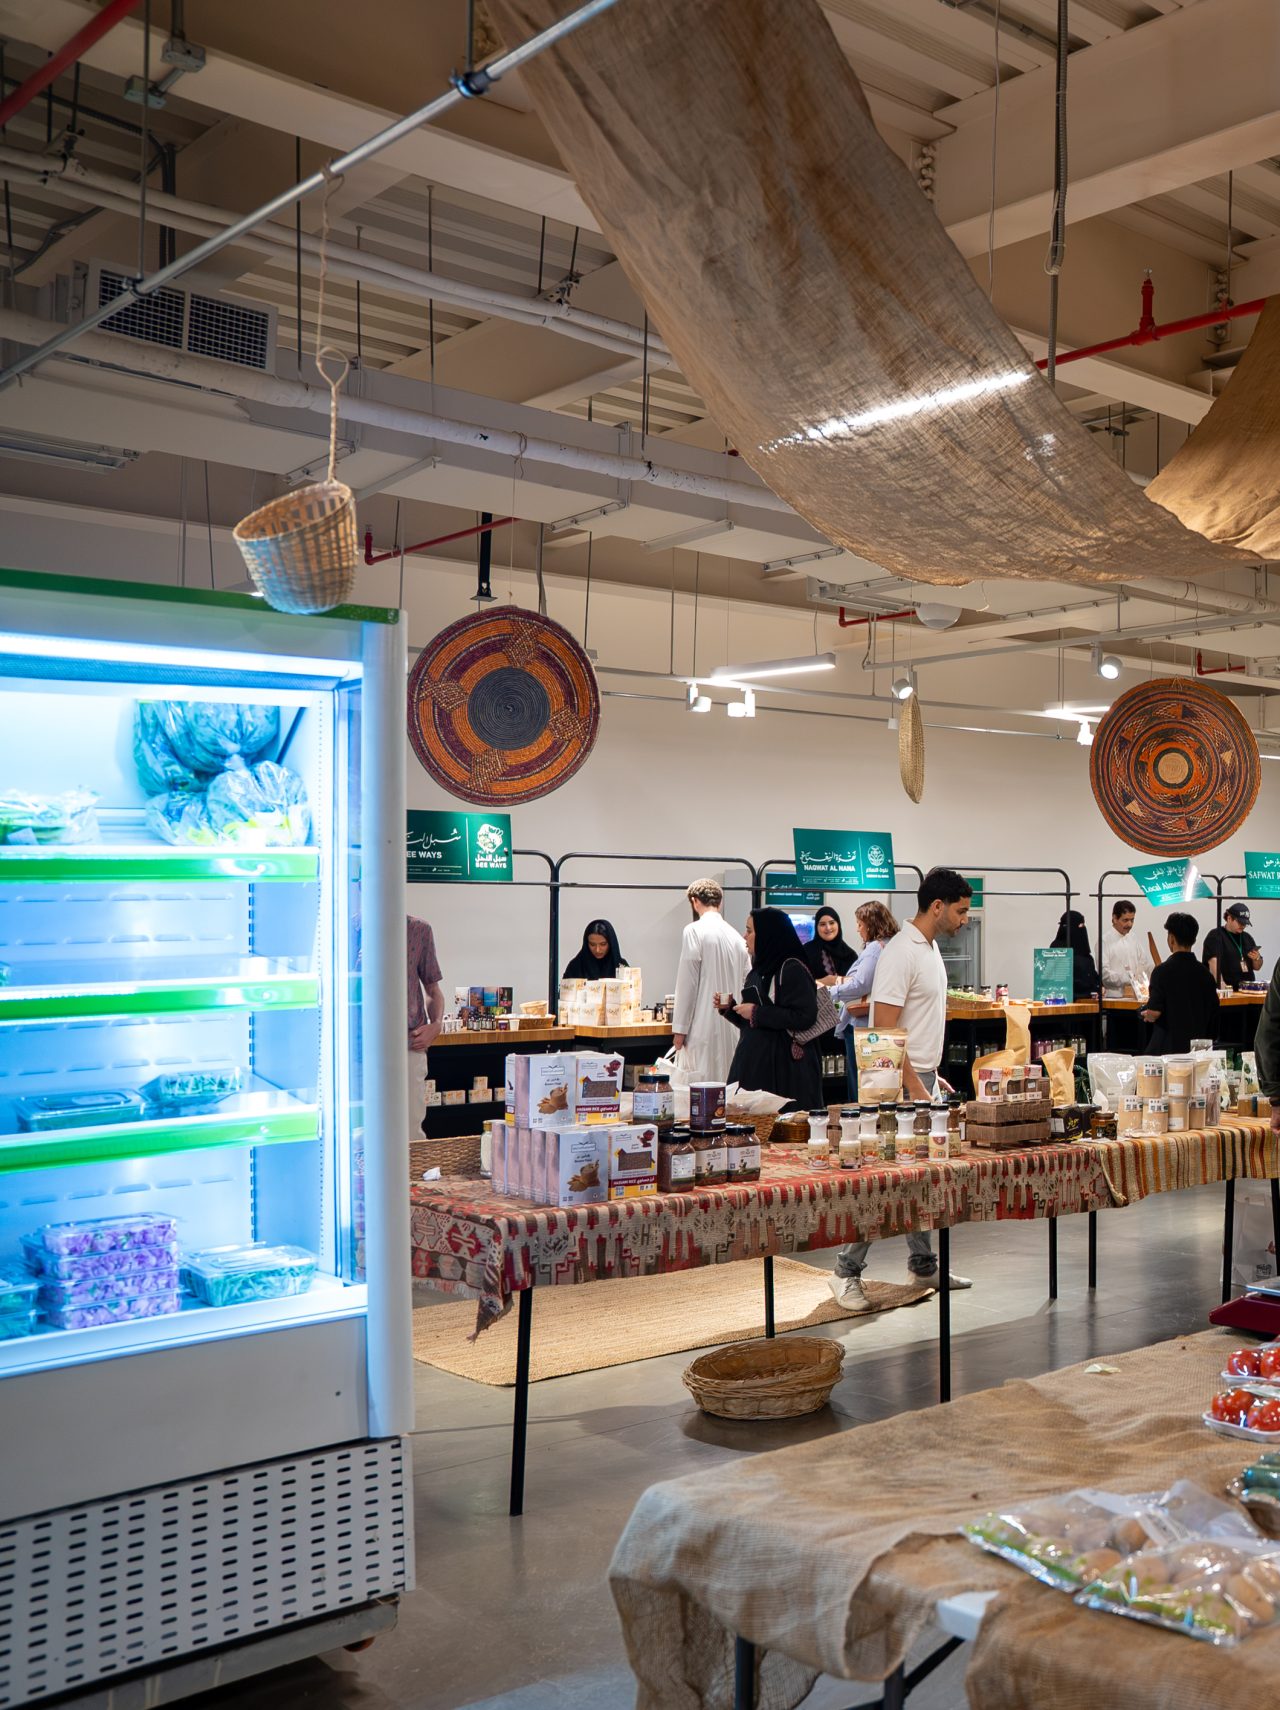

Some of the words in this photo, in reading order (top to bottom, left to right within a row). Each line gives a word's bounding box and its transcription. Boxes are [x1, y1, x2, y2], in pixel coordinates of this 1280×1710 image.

[418, 851, 443, 859] WAYS
[1248, 871, 1275, 880] SAFWAT
[1141, 883, 1161, 893] Local
